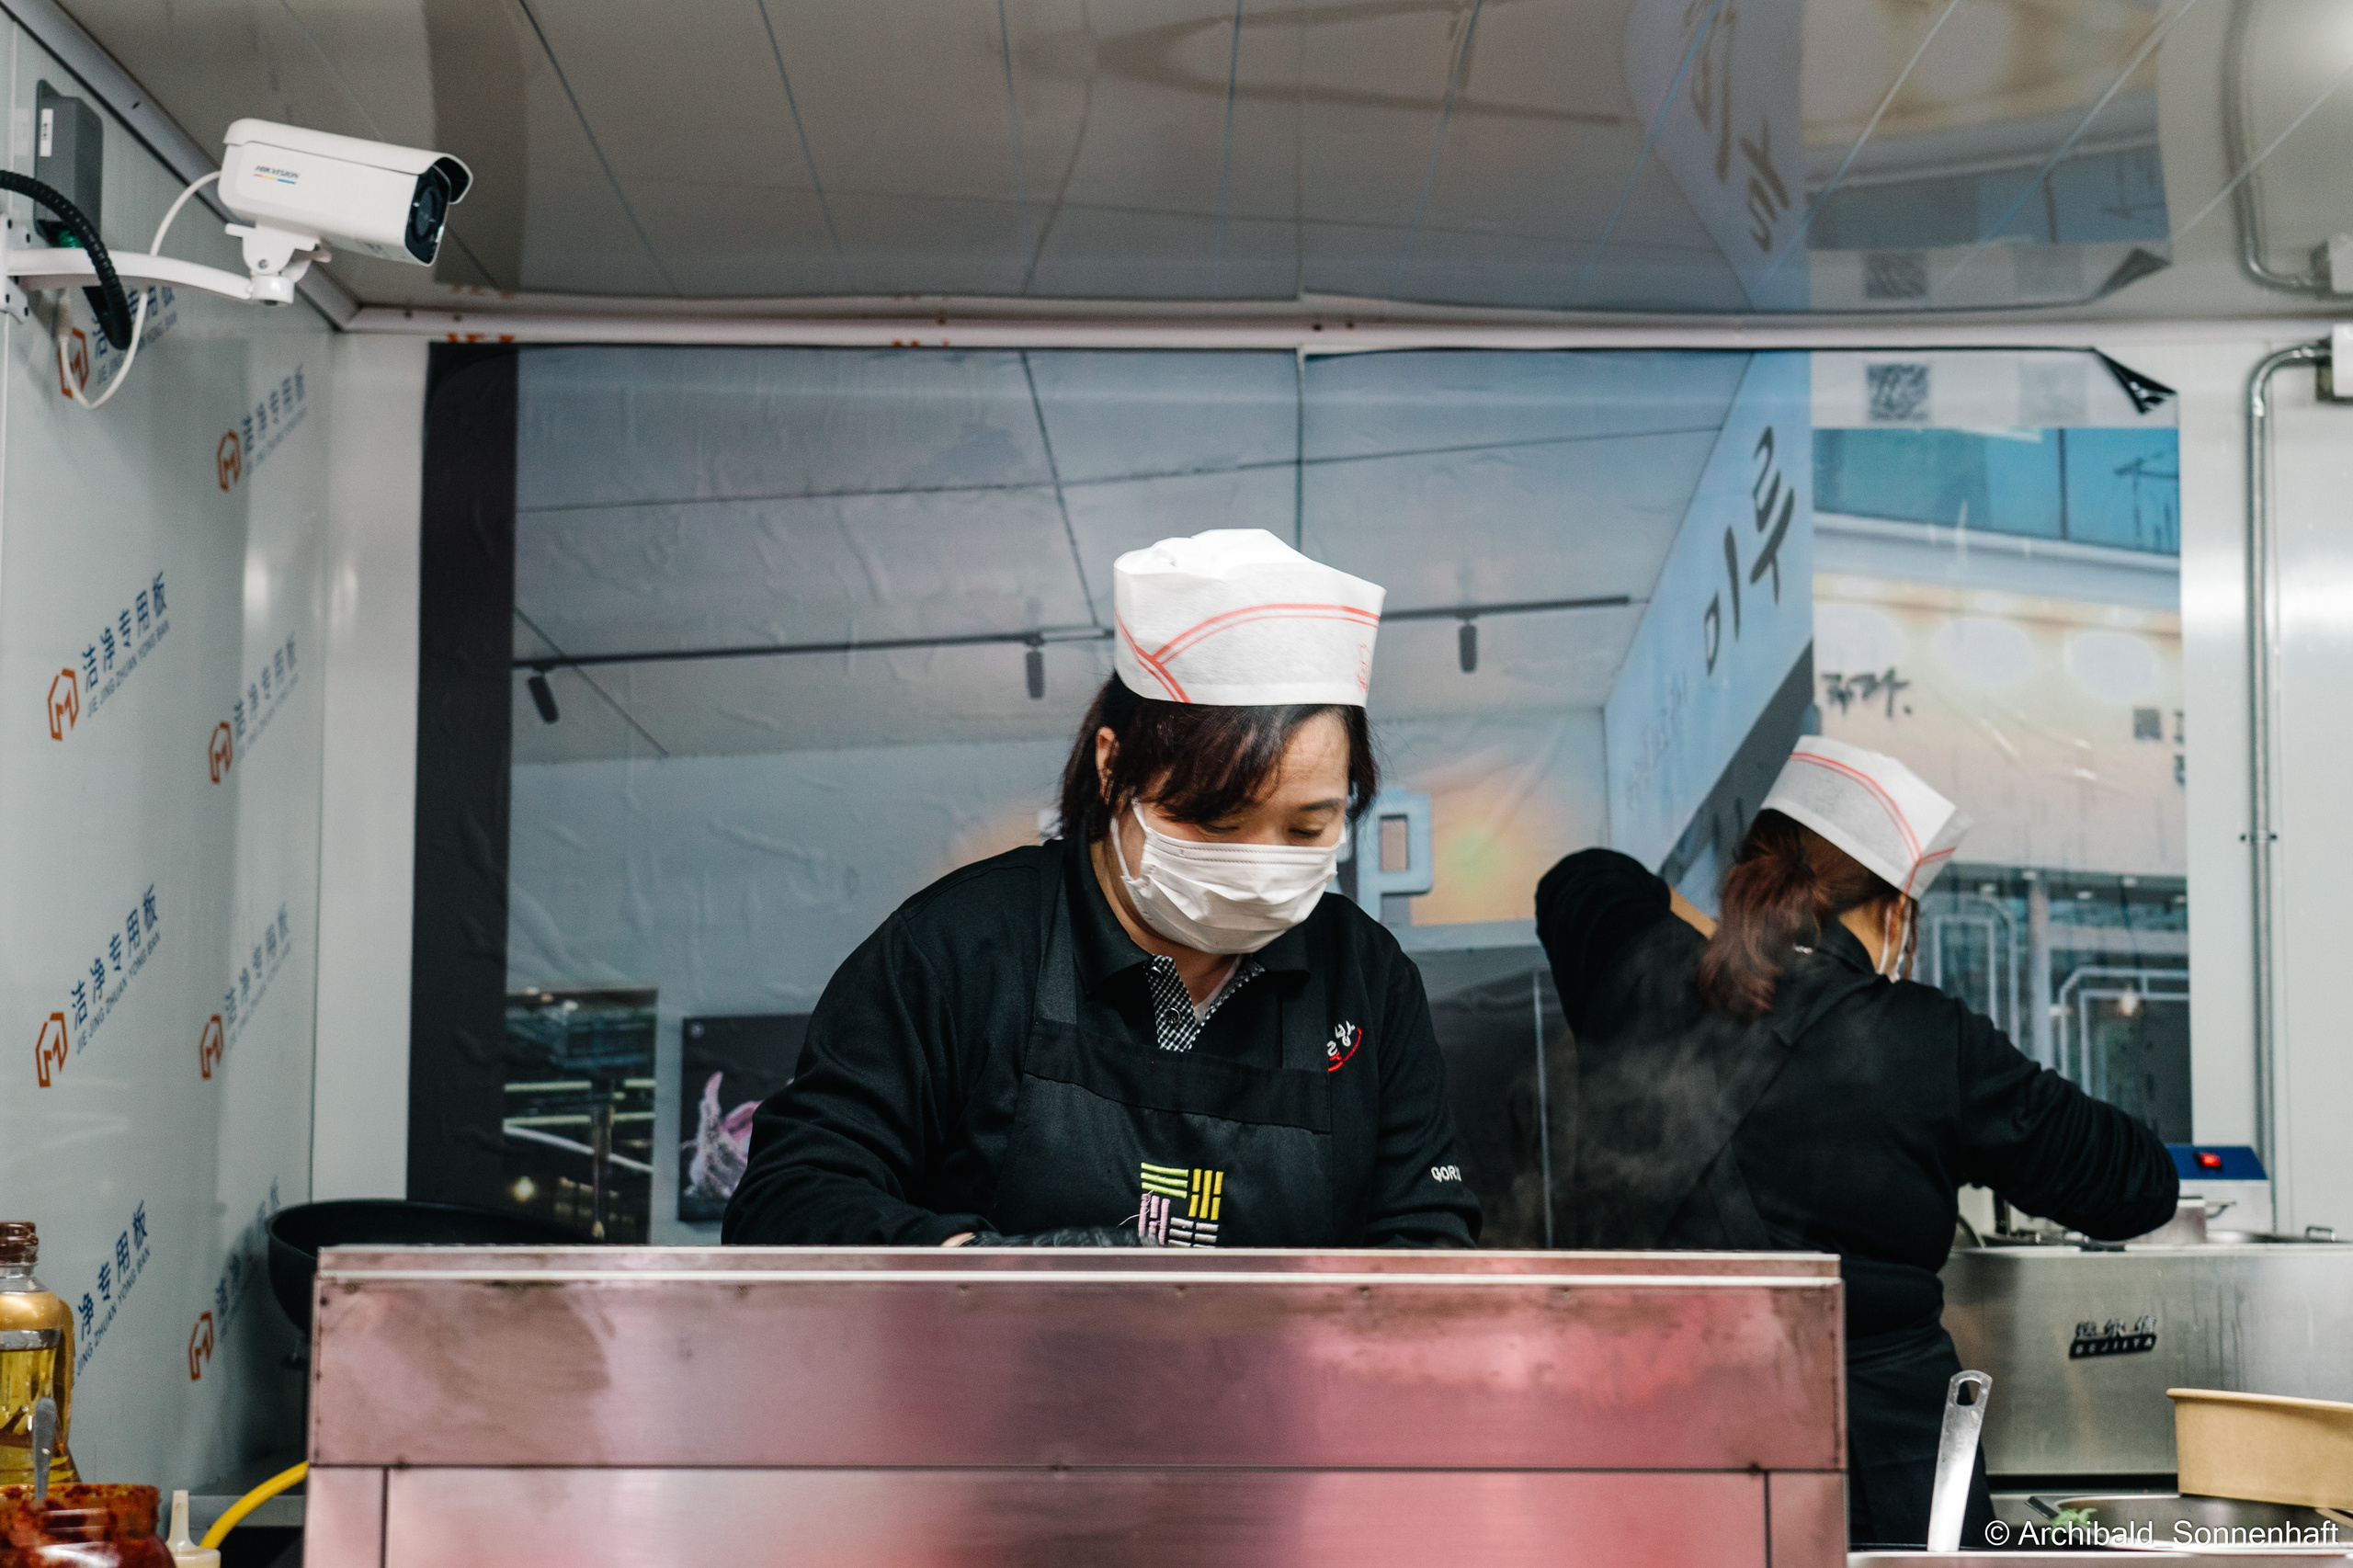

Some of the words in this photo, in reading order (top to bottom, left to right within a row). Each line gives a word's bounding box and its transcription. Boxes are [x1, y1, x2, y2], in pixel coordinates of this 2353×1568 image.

[82, 570, 167, 693] 洁净专用板
[71, 883, 158, 1030] 洁净专用板
[78, 1199, 148, 1342] 净专用板
